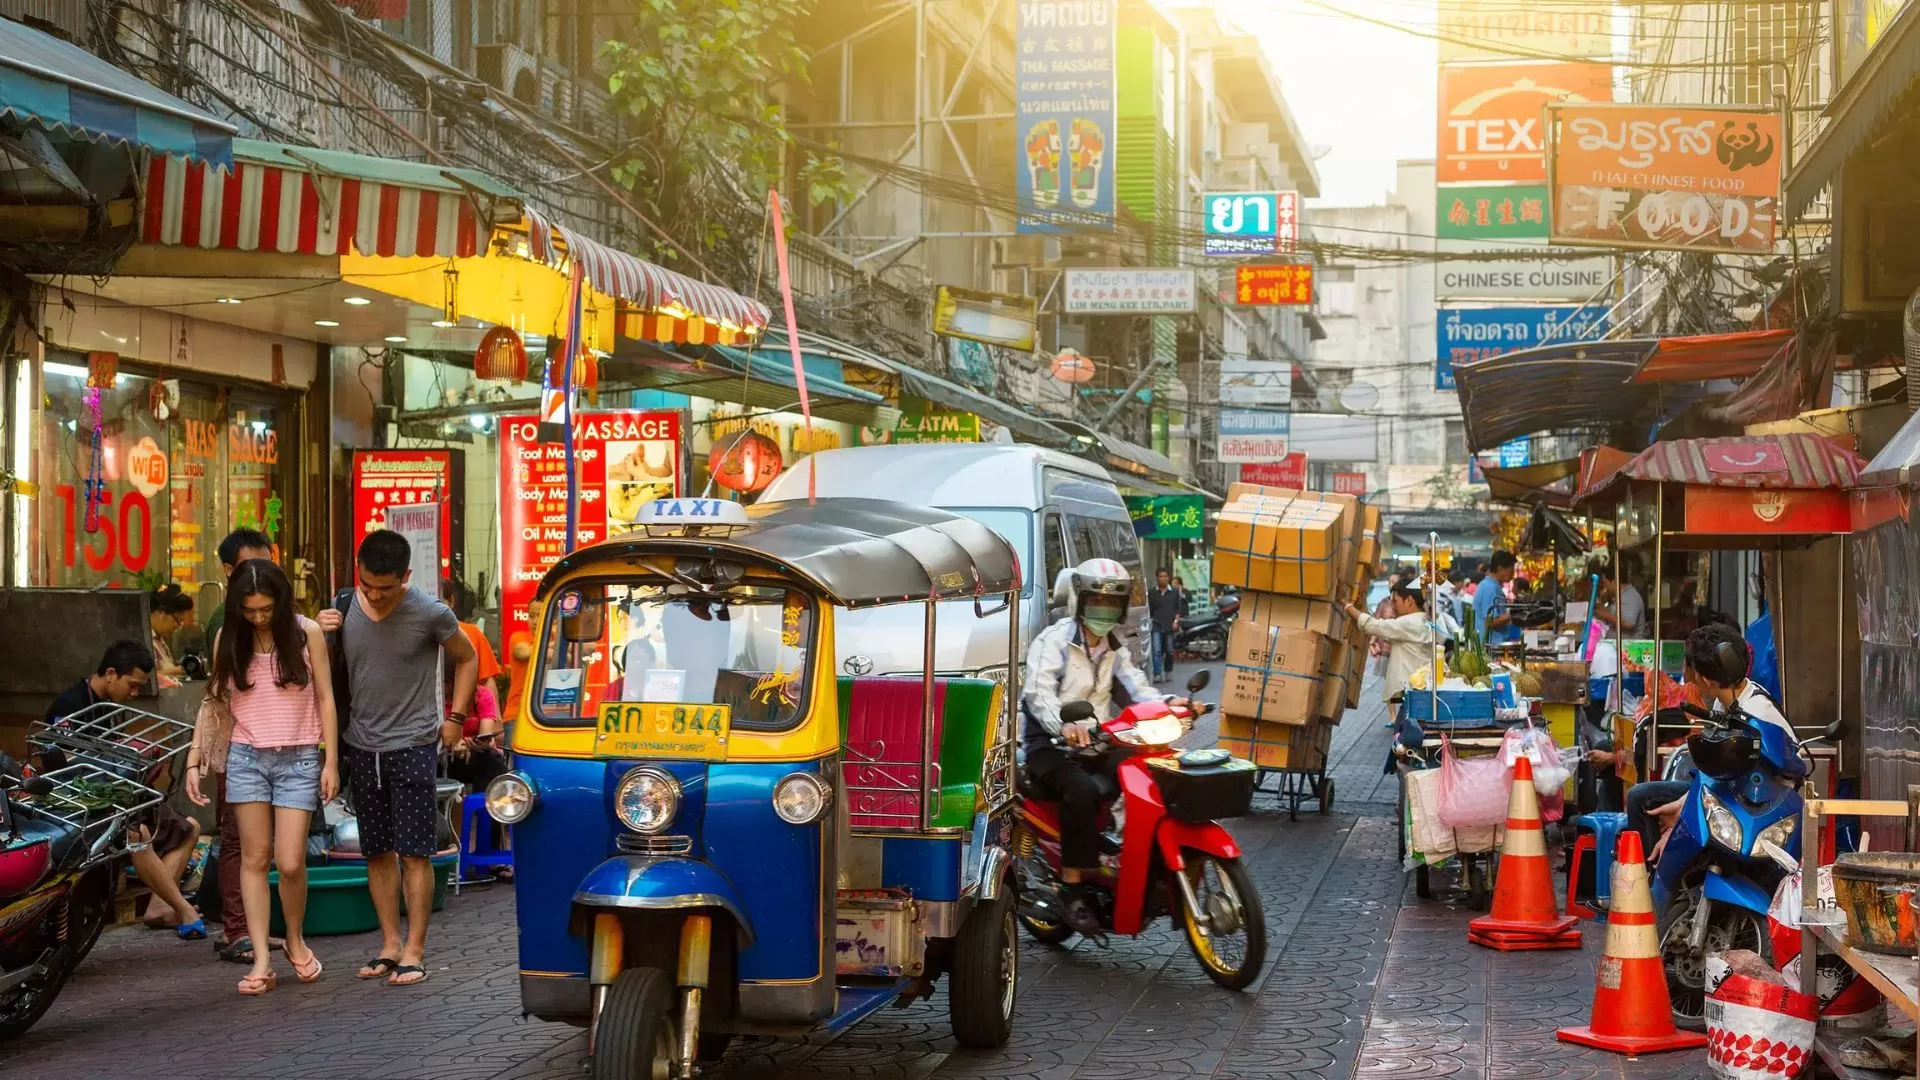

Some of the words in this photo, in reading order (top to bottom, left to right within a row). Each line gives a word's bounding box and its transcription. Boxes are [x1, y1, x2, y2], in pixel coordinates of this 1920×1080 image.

[1051, 58, 1110, 73] MASSAGE
[1590, 169, 1627, 184] THAI
[1633, 173, 1697, 188] CHINESE
[1703, 177, 1745, 191] FOOD
[1212, 196, 1270, 233] ยา
[1594, 187, 1749, 240] FOOD
[1444, 272, 1524, 288] CHINESE
[1529, 271, 1603, 287] CUISINE
[1069, 302, 1087, 310] LIM
[1090, 301, 1118, 310] MENG
[1445, 311, 1528, 342] ที่จอดรถ
[918, 415, 959, 432] ATM
[518, 446, 543, 460] Foot
[516, 486, 544, 502] Body
[654, 500, 721, 518] TAXI
[1157, 506, 1201, 528] 如意
[522, 527, 540, 541] Oil
[604, 705, 643, 733] สก
[654, 706, 722, 736] 5844
